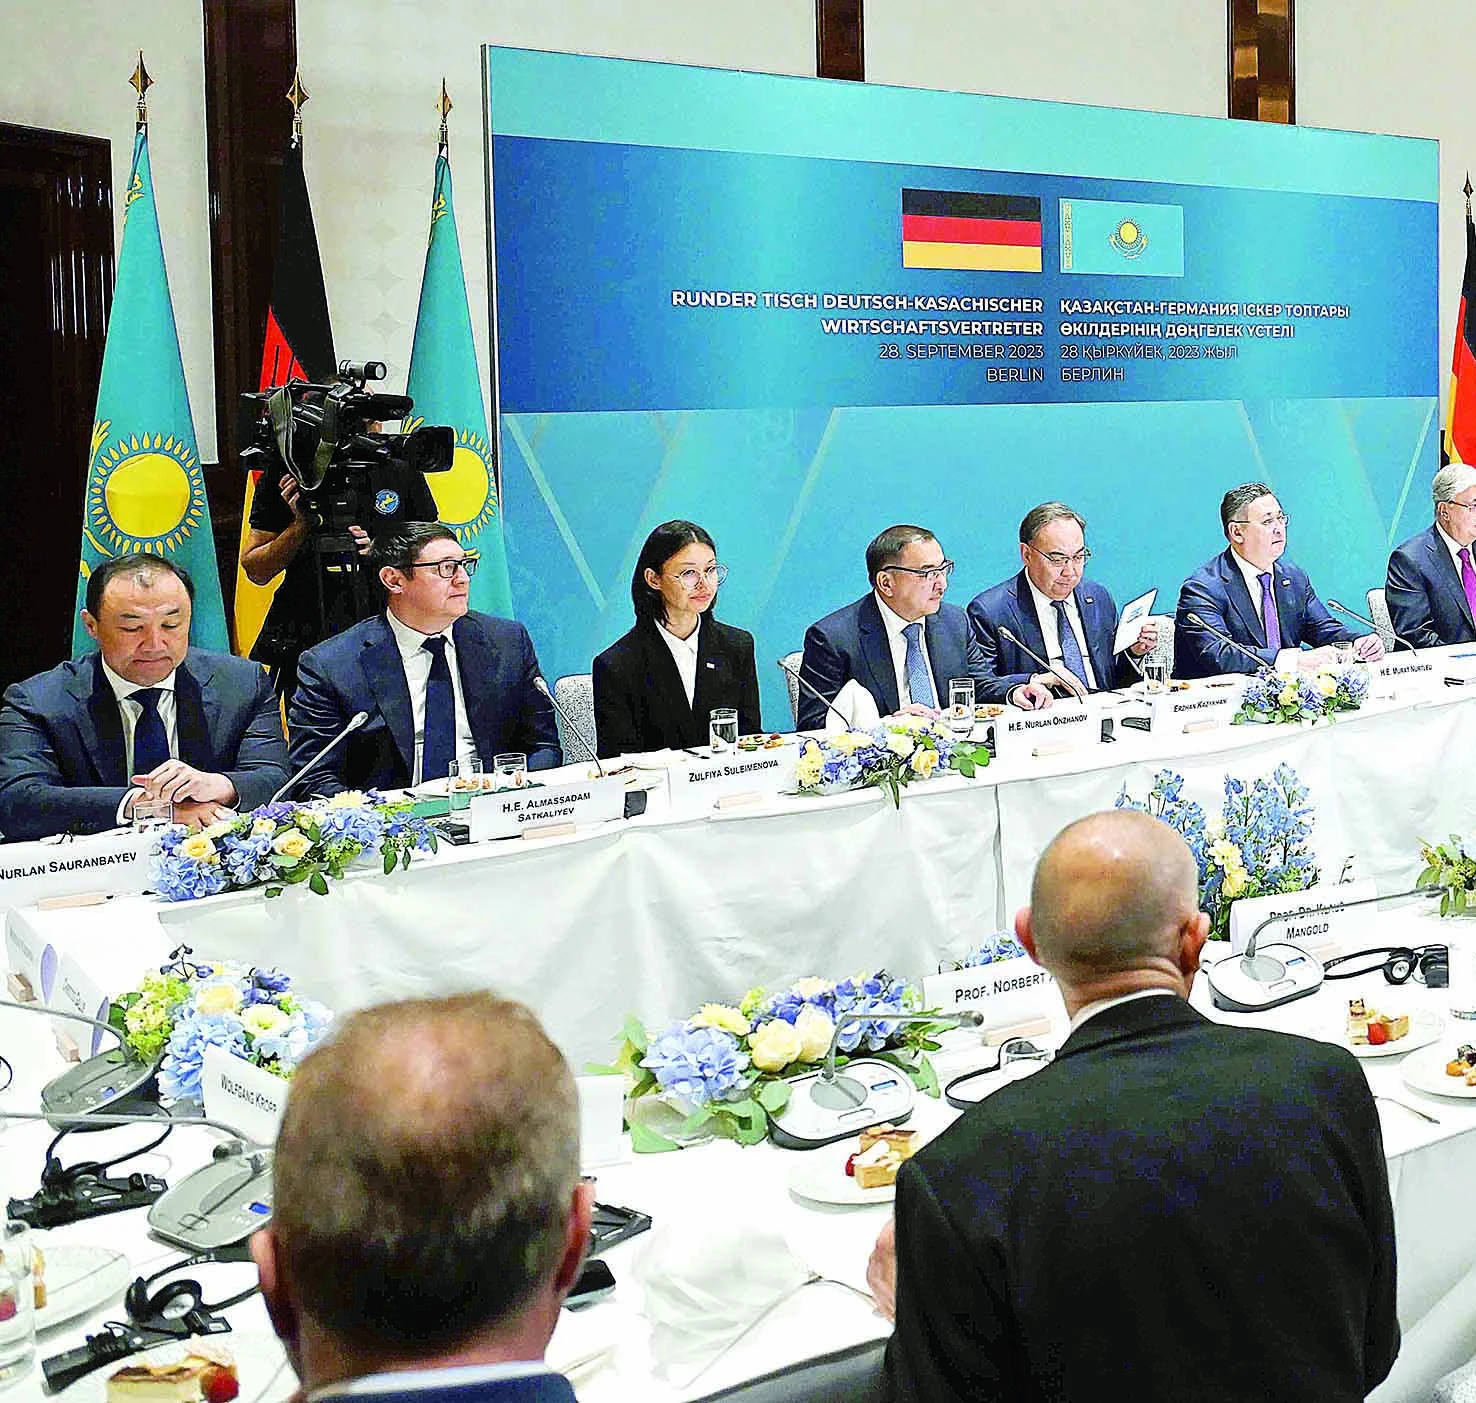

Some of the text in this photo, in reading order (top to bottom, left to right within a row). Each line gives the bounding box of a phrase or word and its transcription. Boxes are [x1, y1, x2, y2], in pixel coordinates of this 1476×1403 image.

[671, 291, 1043, 313] RUNDER TISCH DEUTSCH-KASACHISCHER
[1060, 299, 1349, 318] ҚАЗАҚСТАН-ГЕРМАНИЯ ІСКЕР ТОПТАРЫ
[821, 319, 1043, 336] WIRTSCHAFTSVERTRETER
[1060, 324, 1294, 339] ӨКІЛДЕРІНІҢ ДӨҢГЕЛЕК ҮСТЕЛІ
[879, 344, 1043, 359] 28. SEPTEMBER 2023
[1060, 345, 1078, 359] 28
[1168, 345, 1200, 359] 2023
[1202, 345, 1237, 359] ЖЫЛ
[986, 367, 1043, 382] BERLIN
[1061, 367, 1124, 382] БЕРЛИН
[1008, 722, 1024, 732] H.E.
[1025, 719, 1052, 729] NURLAN
[688, 759, 779, 782] ZULFIYA SULEIMENOVA
[502, 792, 591, 813] H.E. ALMASSADAM
[518, 807, 575, 822] SATKALIYEV
[0, 851, 137, 880] NURLAN SAURANBAYEV
[1286, 923, 1329, 939] MANGOLD
[955, 972, 1045, 1003] PROF. NORBERT
